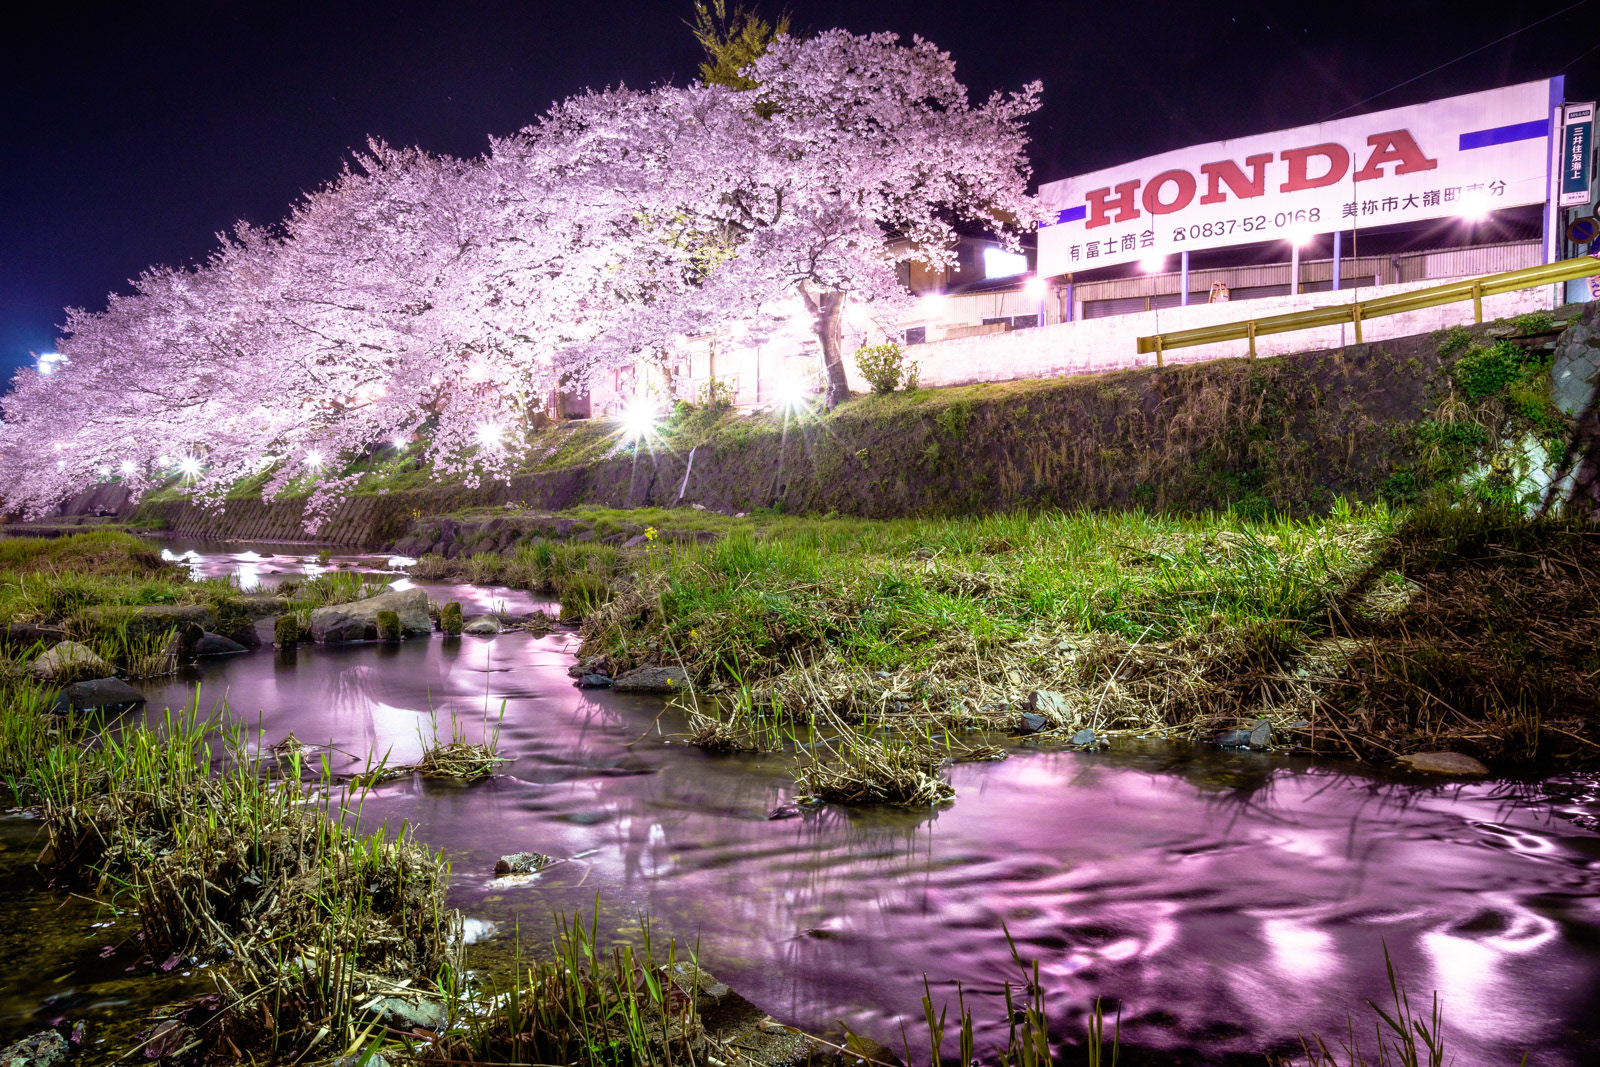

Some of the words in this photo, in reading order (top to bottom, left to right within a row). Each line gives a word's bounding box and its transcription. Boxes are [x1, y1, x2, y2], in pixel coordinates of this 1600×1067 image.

[1085, 128, 1437, 229] HONDA
[1571, 127, 1584, 180] 三井住友海上
[1190, 207, 1321, 239] 0837-52-0168
